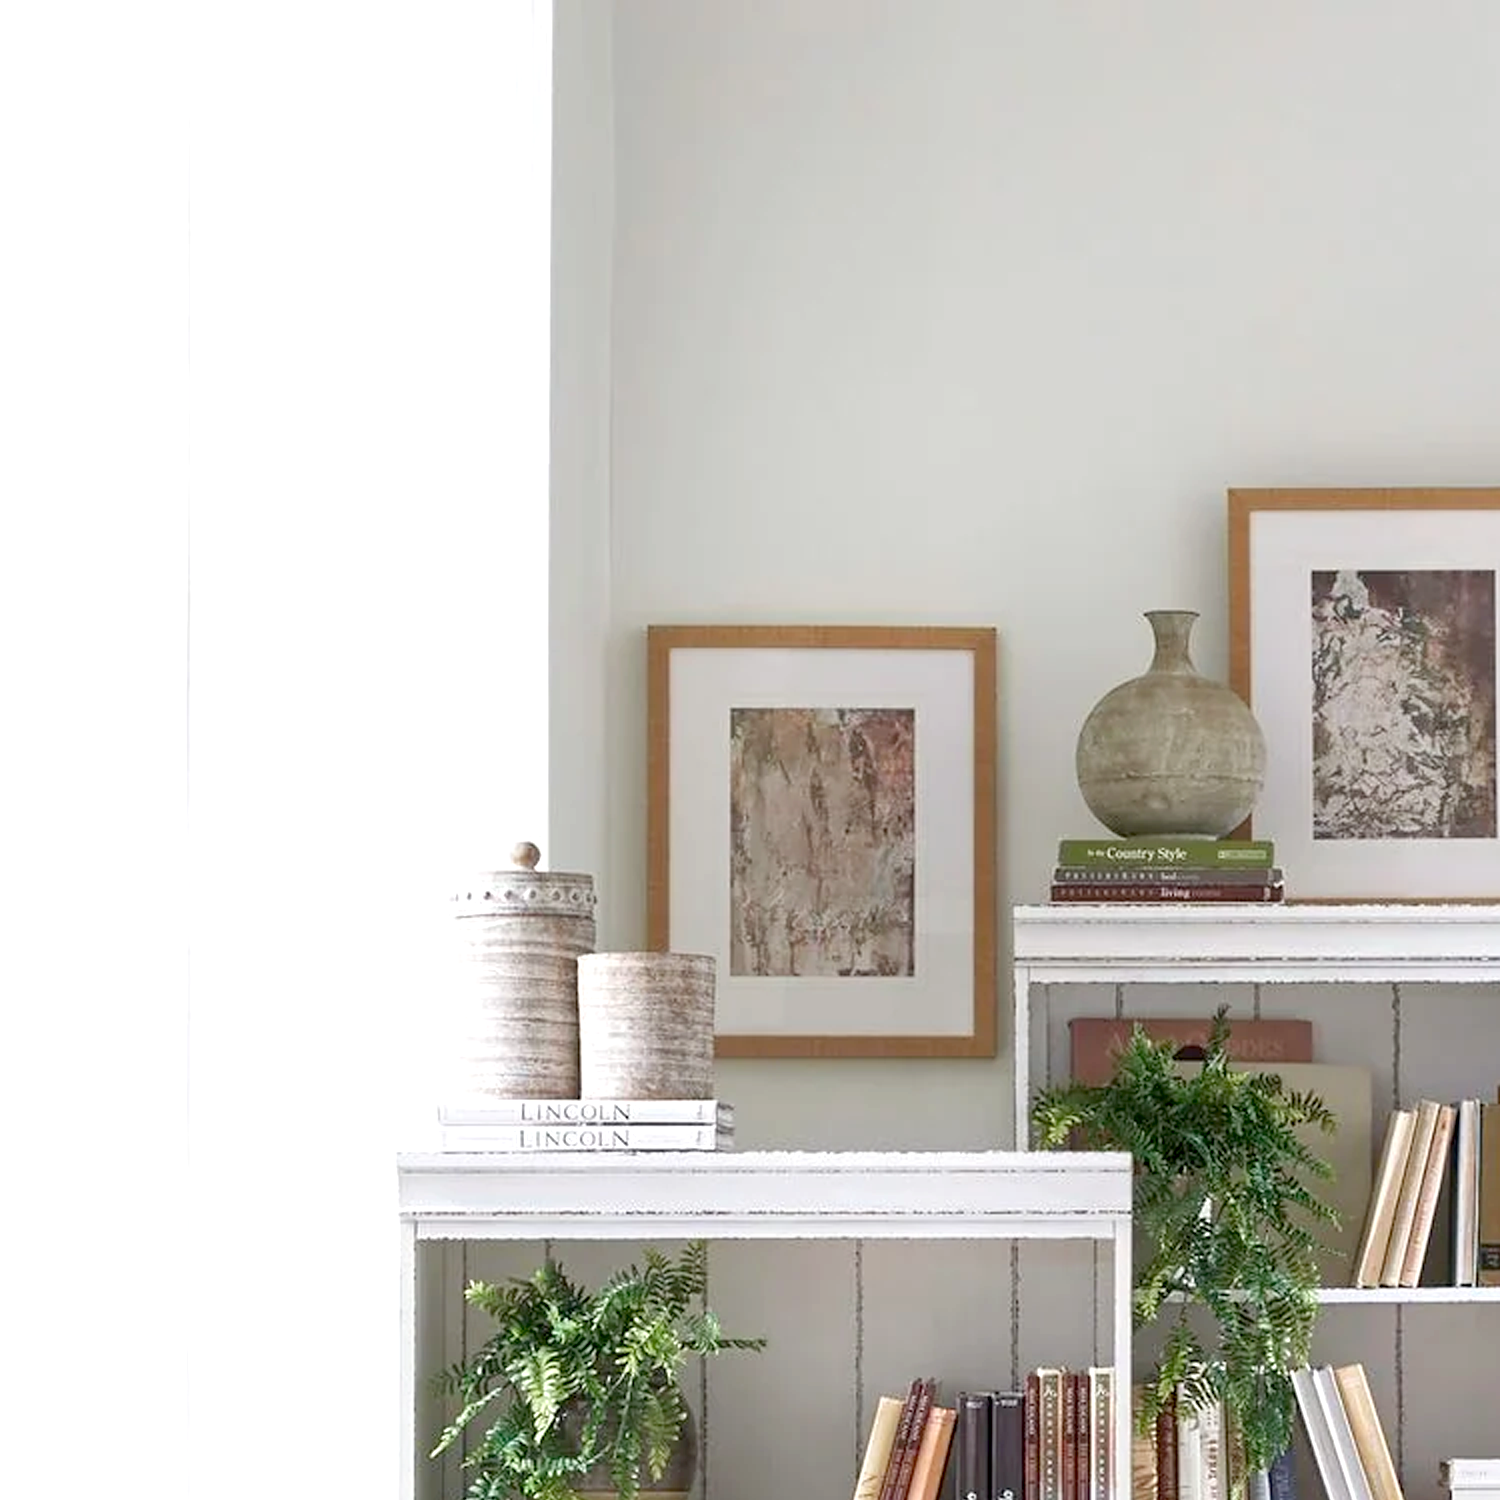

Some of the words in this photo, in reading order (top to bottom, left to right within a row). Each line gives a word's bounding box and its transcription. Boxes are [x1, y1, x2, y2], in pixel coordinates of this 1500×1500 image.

[1107, 847, 1155, 862] Country
[1157, 847, 1188, 862] Style
[520, 1104, 630, 1121] LINCOLN
[519, 1130, 629, 1147] LINCOLN
